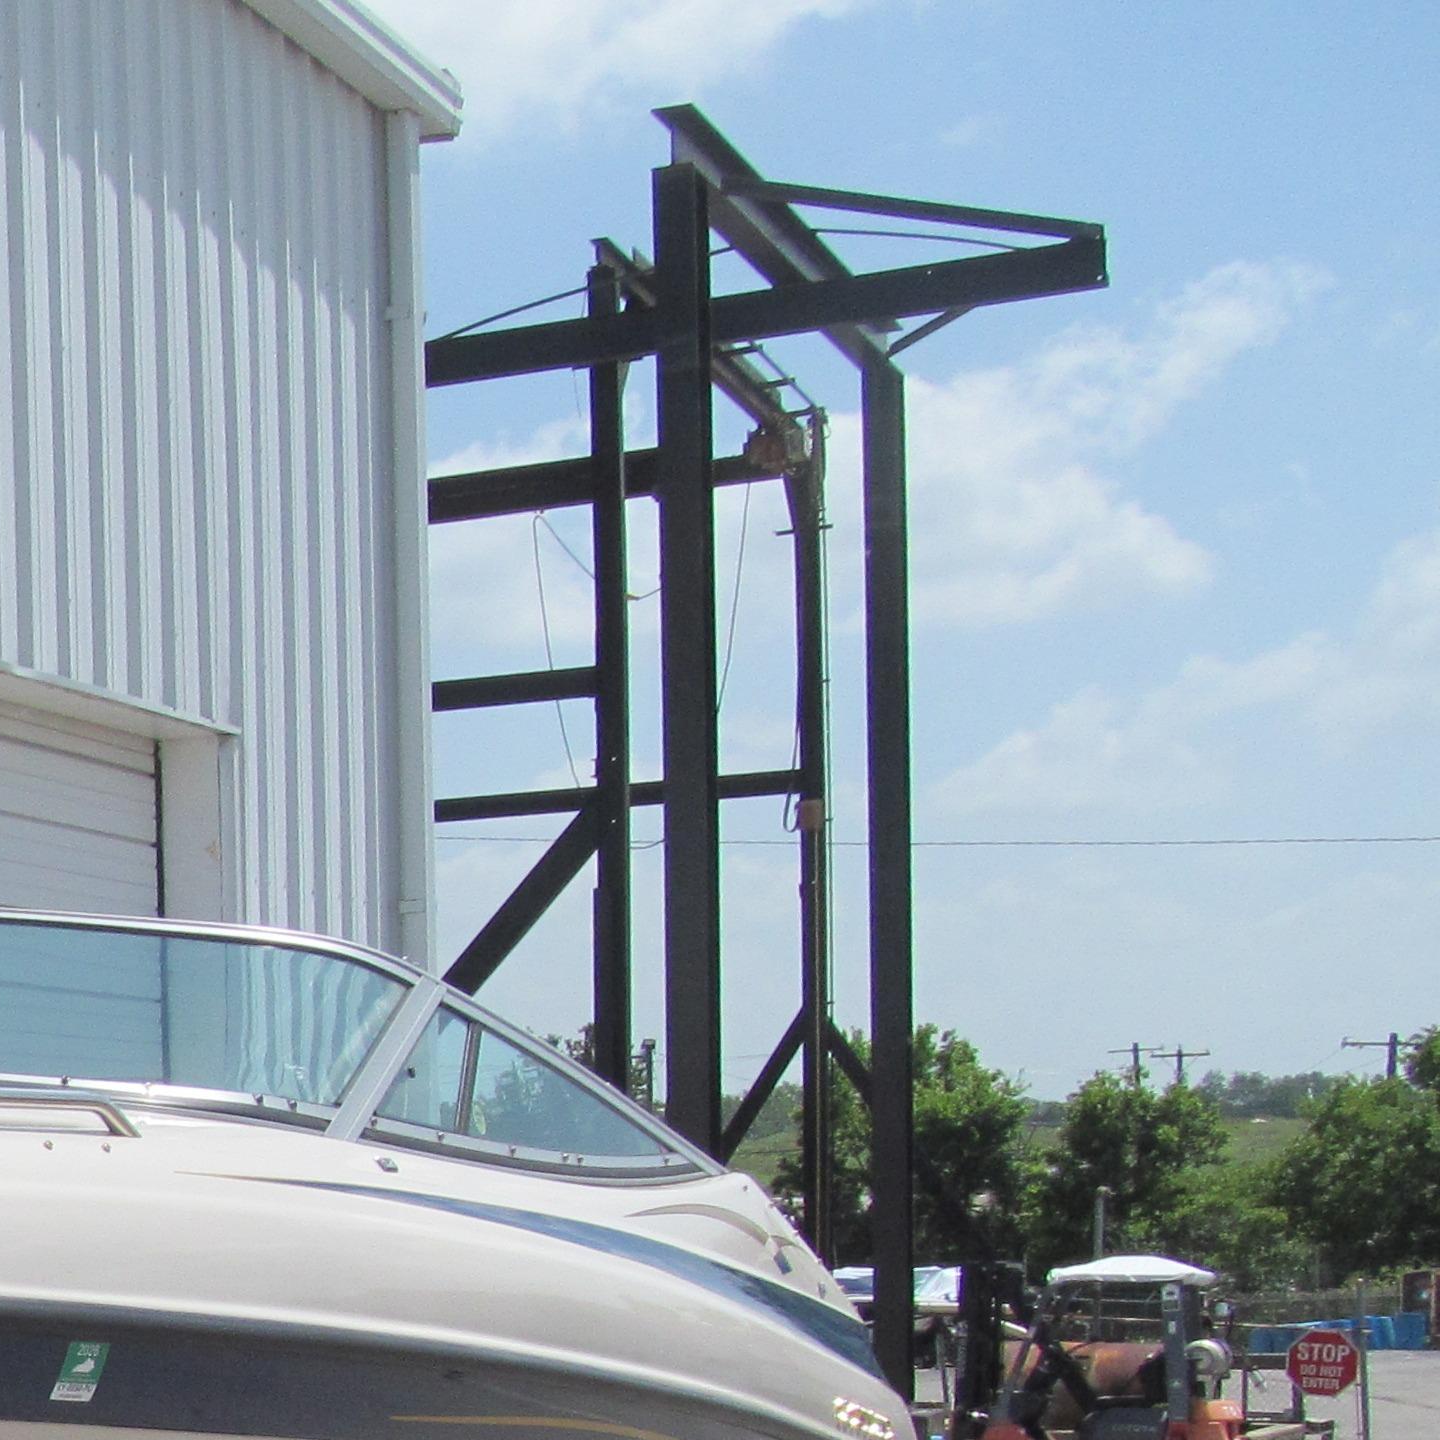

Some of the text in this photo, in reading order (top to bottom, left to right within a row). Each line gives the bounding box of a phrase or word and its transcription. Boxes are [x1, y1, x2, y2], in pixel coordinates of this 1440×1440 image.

[1297, 1342, 1350, 1363] STOP
[1300, 1364, 1344, 1377] DO NOT
[1302, 1376, 1340, 1390] ENTER
